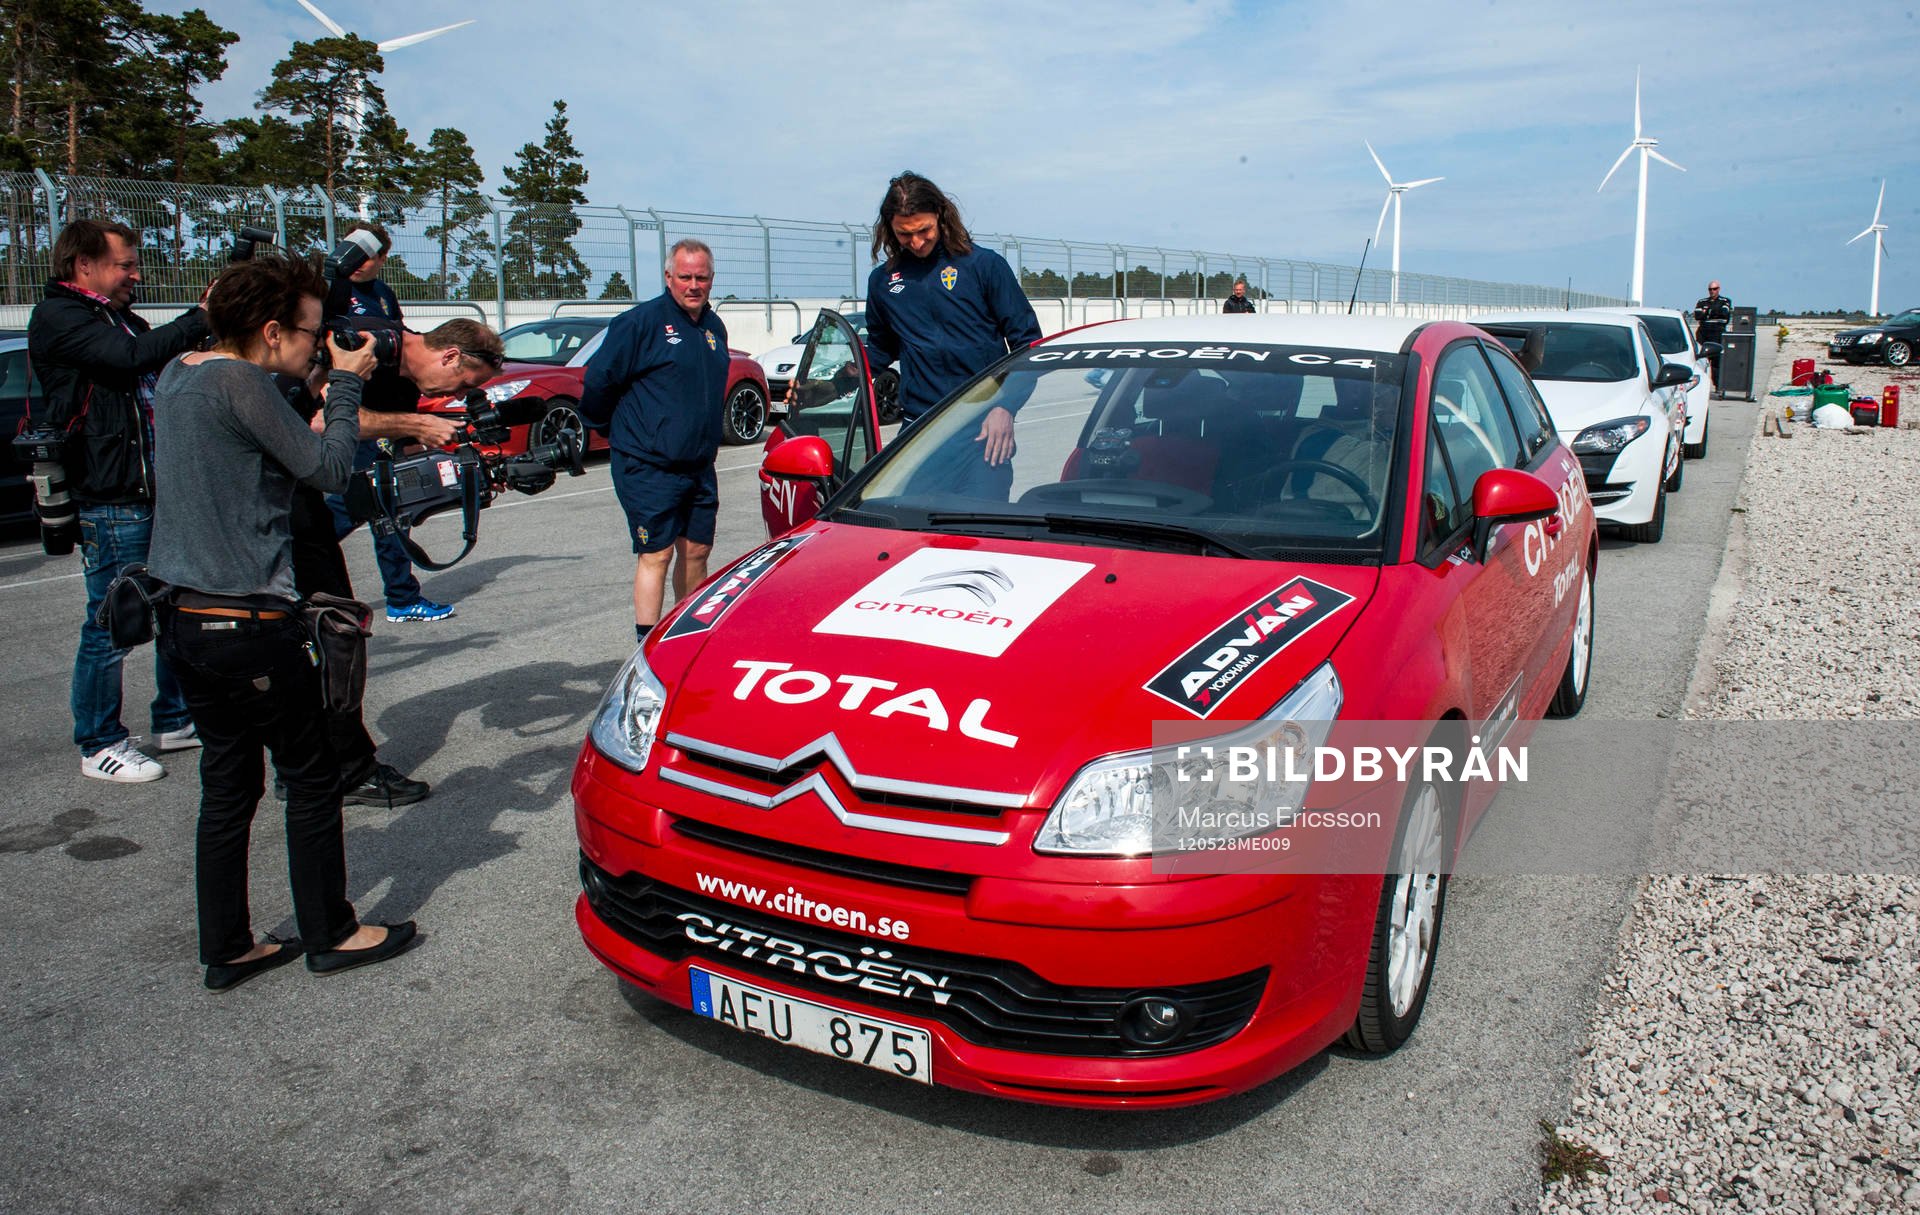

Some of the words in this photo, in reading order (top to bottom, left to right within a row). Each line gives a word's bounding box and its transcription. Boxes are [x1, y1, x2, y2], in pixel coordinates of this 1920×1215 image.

[1028, 346, 1271, 363] CITROËN
[1288, 354, 1376, 369] C4
[1553, 552, 1580, 609] TOTAL
[1180, 594, 1315, 699] ADVAN
[1208, 653, 1259, 692] YOKOHAMA
[732, 660, 1019, 748] TOTAL
[696, 872, 910, 940] www.citroen.se
[676, 913, 951, 1005] CITROËN
[700, 1001, 707, 1012] S
[720, 984, 792, 1042] AEU
[829, 1016, 917, 1077] 875
